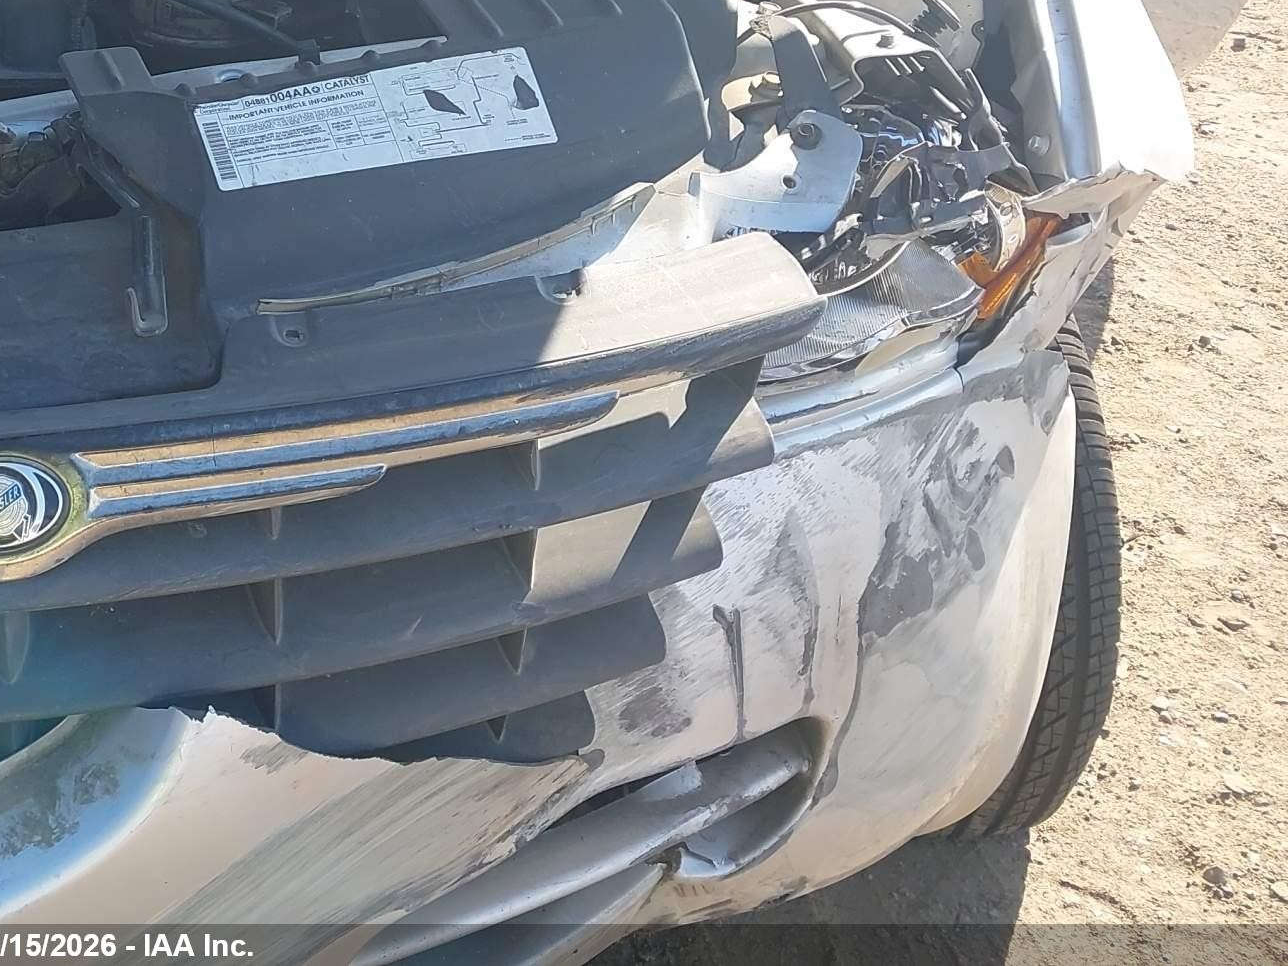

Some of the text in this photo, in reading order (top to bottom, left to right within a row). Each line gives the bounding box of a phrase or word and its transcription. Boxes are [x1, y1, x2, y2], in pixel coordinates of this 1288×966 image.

[324, 74, 369, 91] CATALYST
[228, 107, 273, 121] IMPORTANT
[275, 100, 307, 114] VEHICLE
[309, 90, 364, 106] INFORMATION
